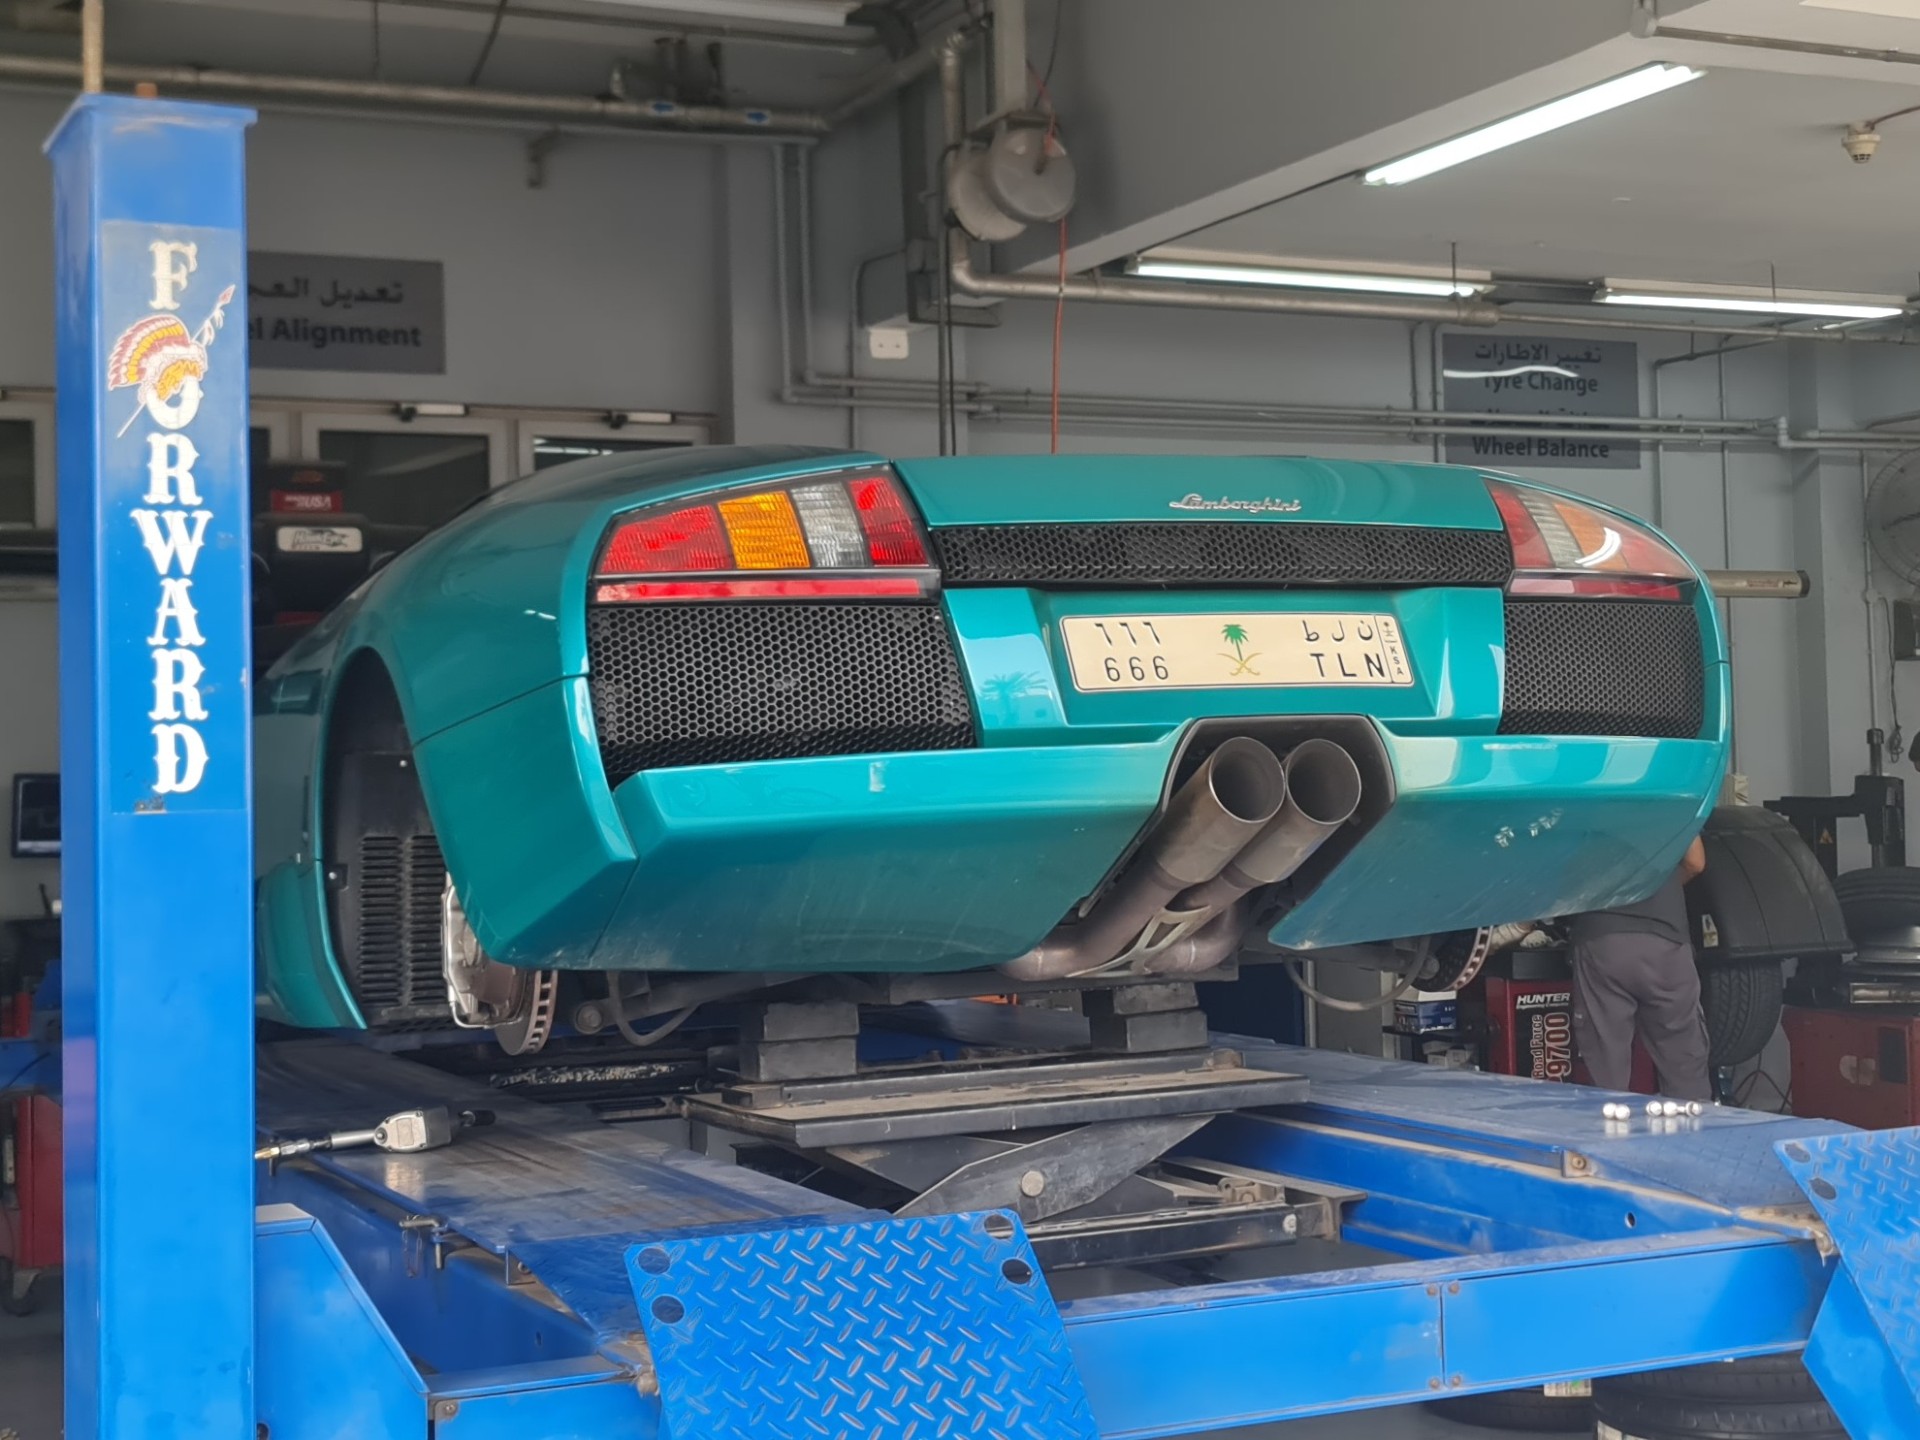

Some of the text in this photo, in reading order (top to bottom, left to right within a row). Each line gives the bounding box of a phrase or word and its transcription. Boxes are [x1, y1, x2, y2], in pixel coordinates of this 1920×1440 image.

[320, 279, 405, 309] تعديل
[272, 317, 422, 349] Alignment
[1484, 372, 1599, 397] Tyre Change
[1472, 435, 1610, 459] Wheel Balance
[129, 240, 213, 794] FORWARD
[1169, 493, 1302, 513] Lamborghini
[1104, 653, 1386, 681] 666 TLN
[1517, 992, 1571, 1005] HUNTER
[1530, 1014, 1545, 1079] Road Force
[1544, 1012, 1572, 1084] 9700
